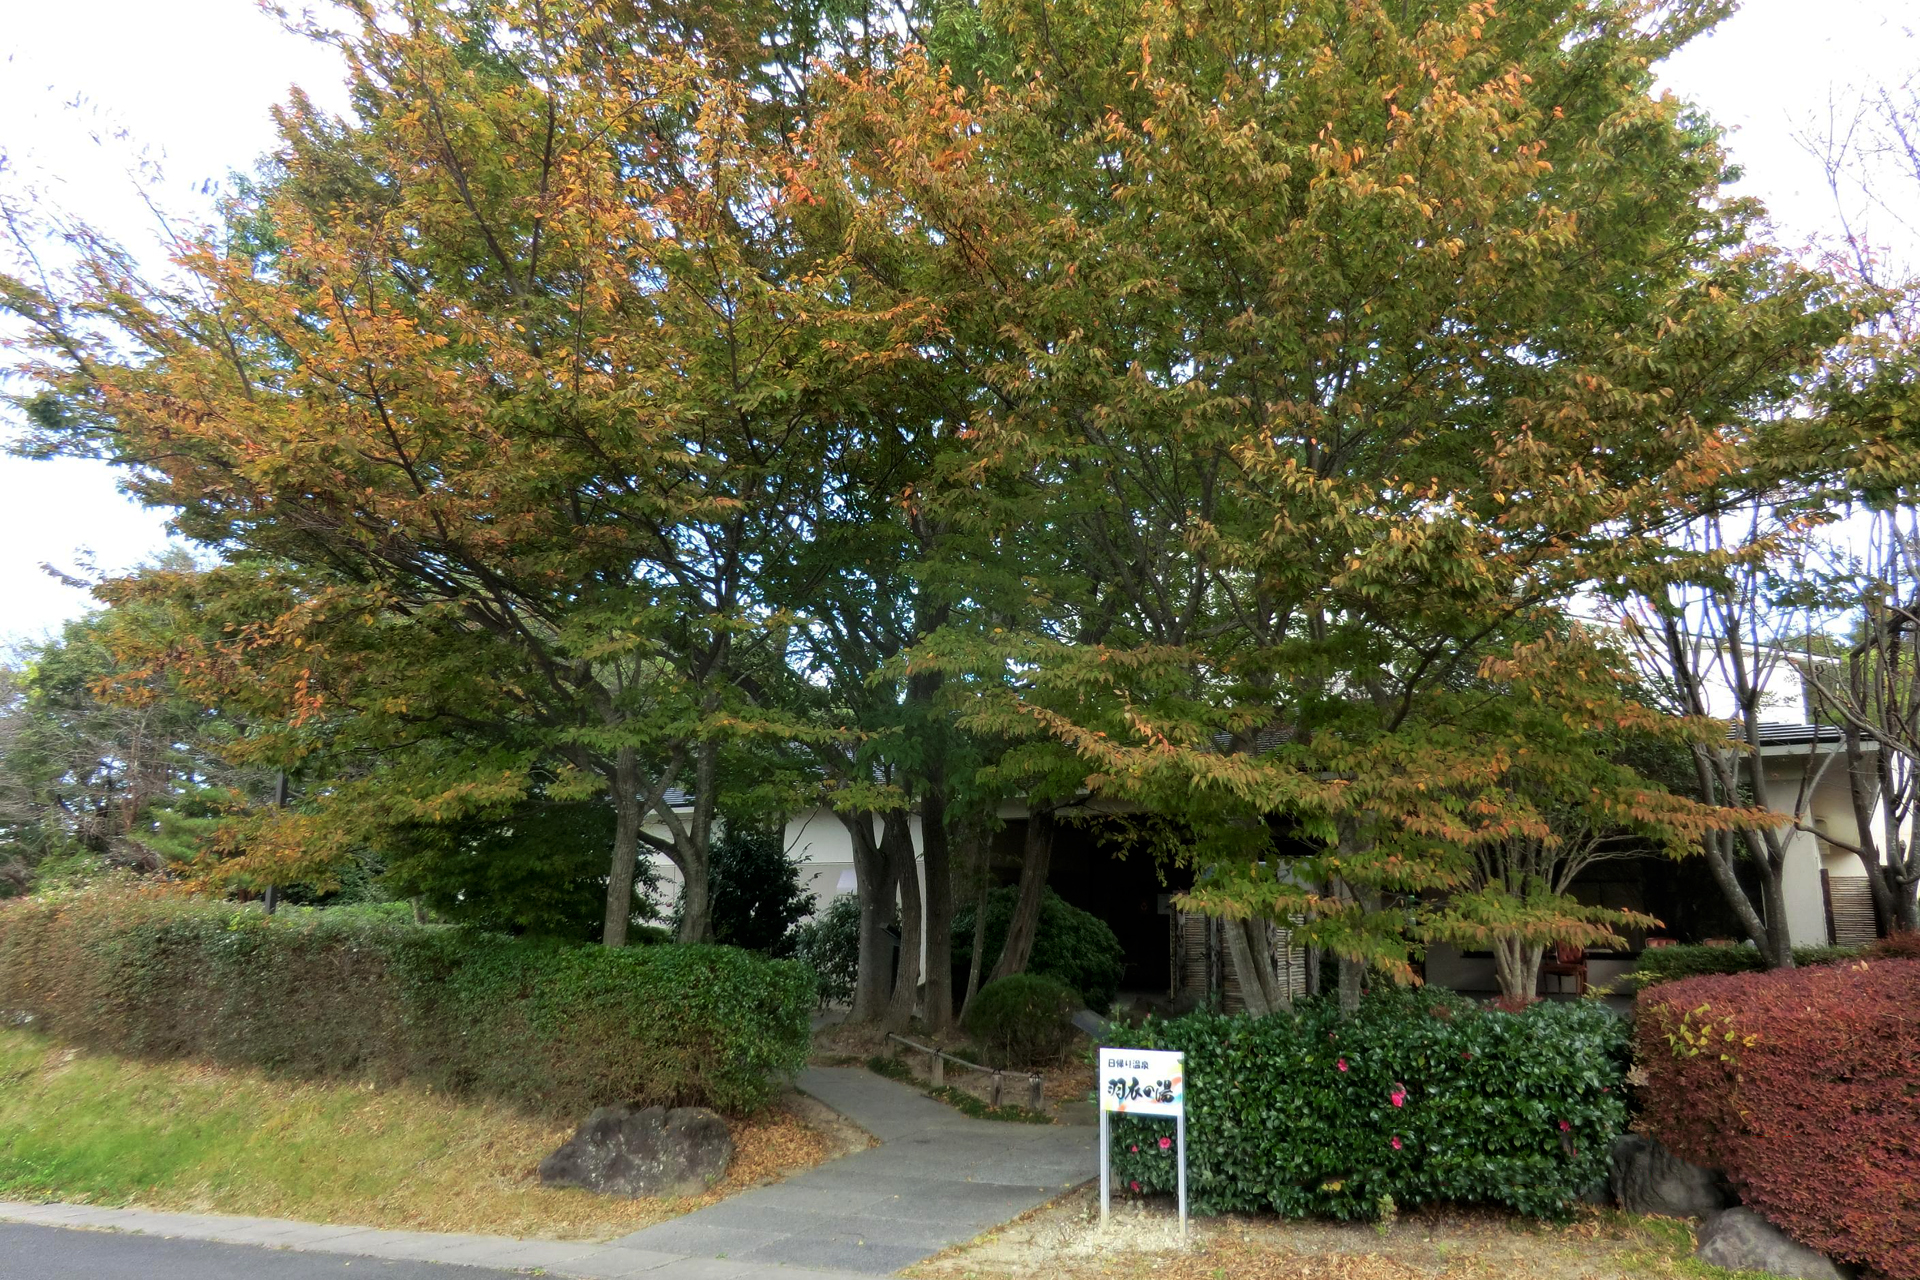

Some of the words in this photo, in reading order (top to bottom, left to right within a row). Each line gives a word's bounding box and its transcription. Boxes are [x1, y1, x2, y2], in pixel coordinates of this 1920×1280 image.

[1108, 1058, 1149, 1070] 日帰り温泉
[1107, 1077, 1175, 1103] 羽衣の湯
